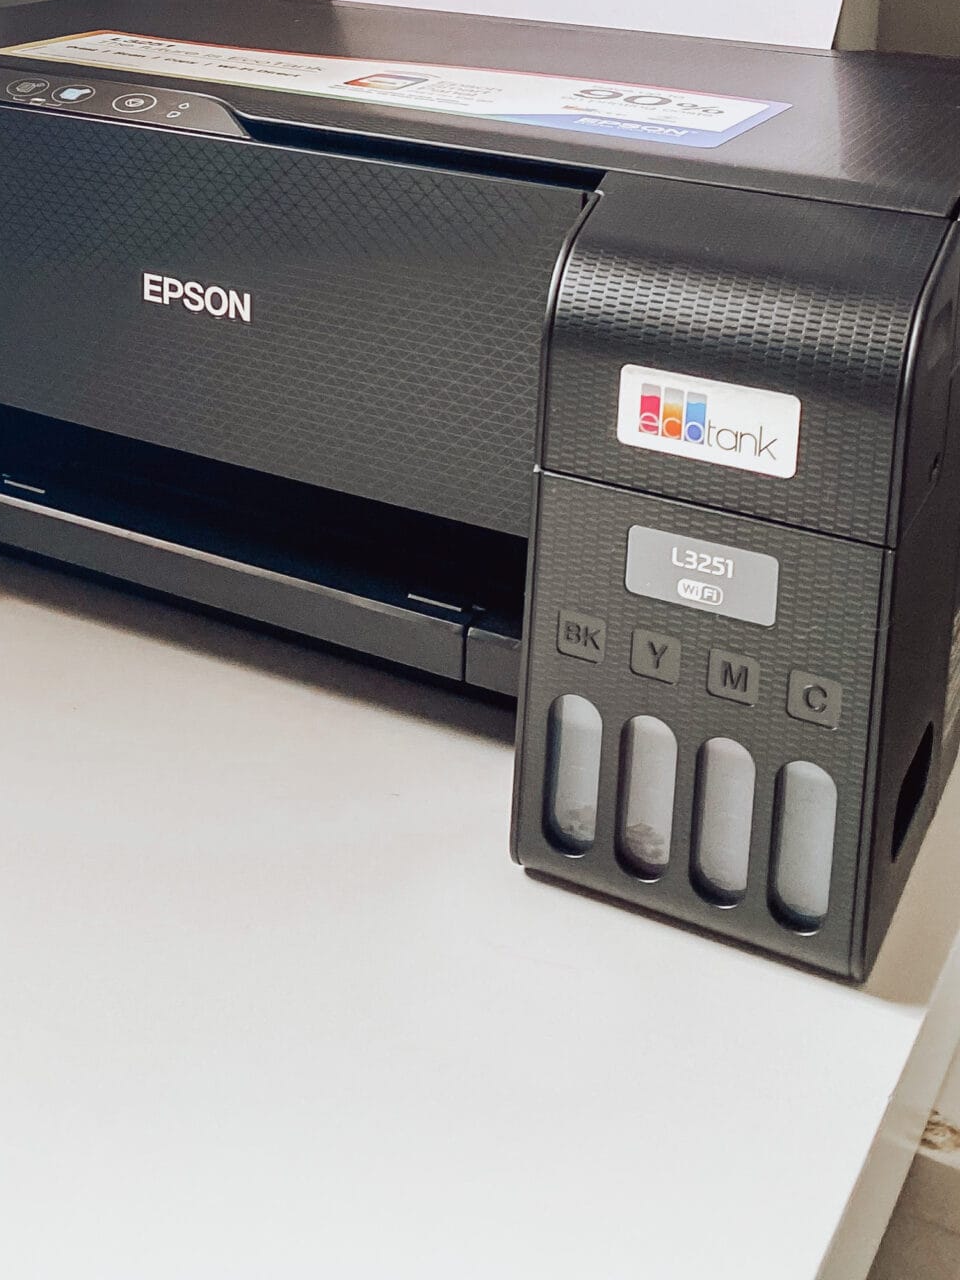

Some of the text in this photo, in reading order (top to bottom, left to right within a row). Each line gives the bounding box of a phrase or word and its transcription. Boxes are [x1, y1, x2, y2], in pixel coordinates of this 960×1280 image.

[575, 117, 689, 138] EPSON
[143, 272, 252, 323] EPSON
[639, 410, 778, 461] ecotank
[671, 546, 734, 579] L3251
[565, 622, 601, 651] BK
[647, 640, 669, 669] Y
[720, 661, 749, 693] M
[804, 684, 828, 713] C
